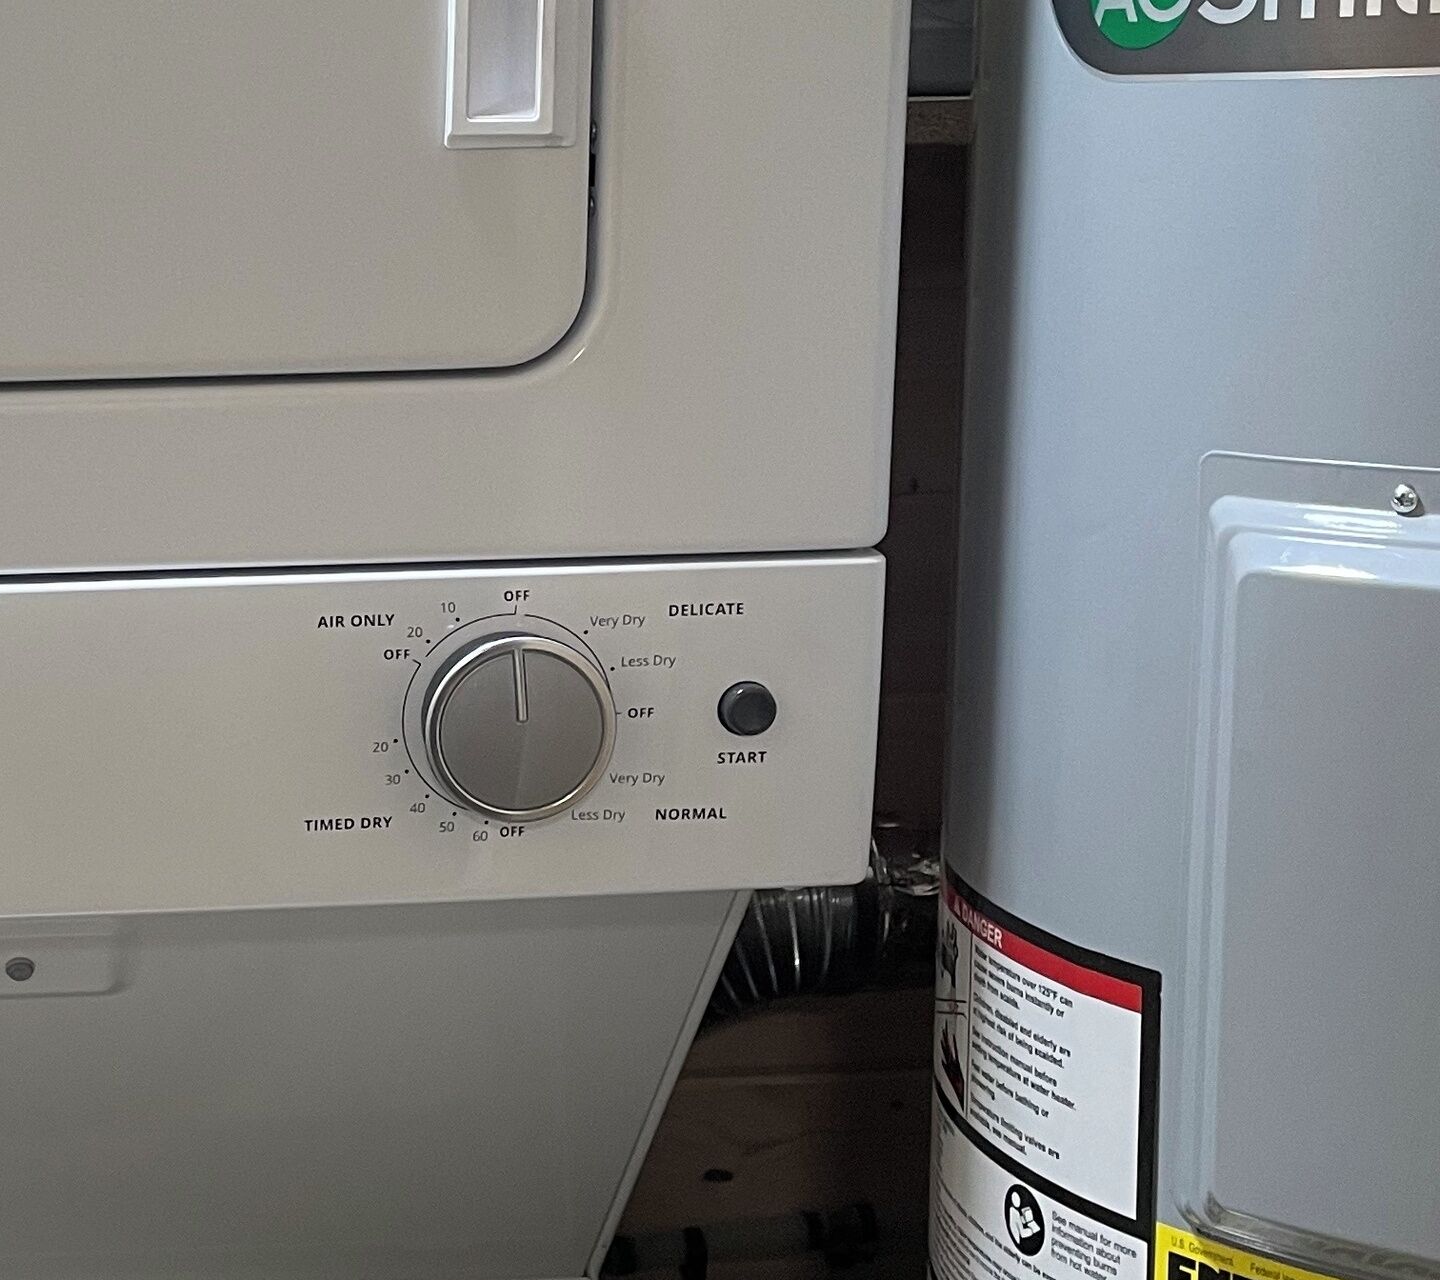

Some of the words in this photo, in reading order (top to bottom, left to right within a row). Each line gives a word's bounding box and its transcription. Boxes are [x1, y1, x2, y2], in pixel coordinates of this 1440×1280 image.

[504, 589, 530, 602] OFF
[441, 602, 456, 613] 10
[669, 603, 744, 617] DELICATE
[318, 615, 345, 629] AIR
[350, 614, 395, 627] ONLY
[590, 616, 619, 629] Very
[623, 614, 645, 627] Dry
[407, 627, 423, 638] 20
[384, 649, 410, 660] OFF
[621, 656, 649, 667] Less
[653, 655, 676, 668] Dry
[628, 708, 655, 718] OFF
[373, 742, 388, 753] 20
[717, 751, 767, 764] START
[385, 774, 400, 785] 30
[610, 774, 639, 786] Very
[643, 772, 666, 785] Dry
[410, 803, 425, 813] 40
[655, 808, 727, 820] NORMAL
[571, 810, 598, 821] Less
[603, 810, 625, 822] Dry
[304, 818, 354, 832] TIMED
[360, 816, 392, 828] DRY
[439, 822, 454, 832] 50
[472, 830, 488, 842] 60
[500, 825, 526, 838] OFF
[962, 910, 1002, 949] DANGER
[1069, 1221, 1097, 1241] manual
[1114, 1243, 1137, 1258] more
